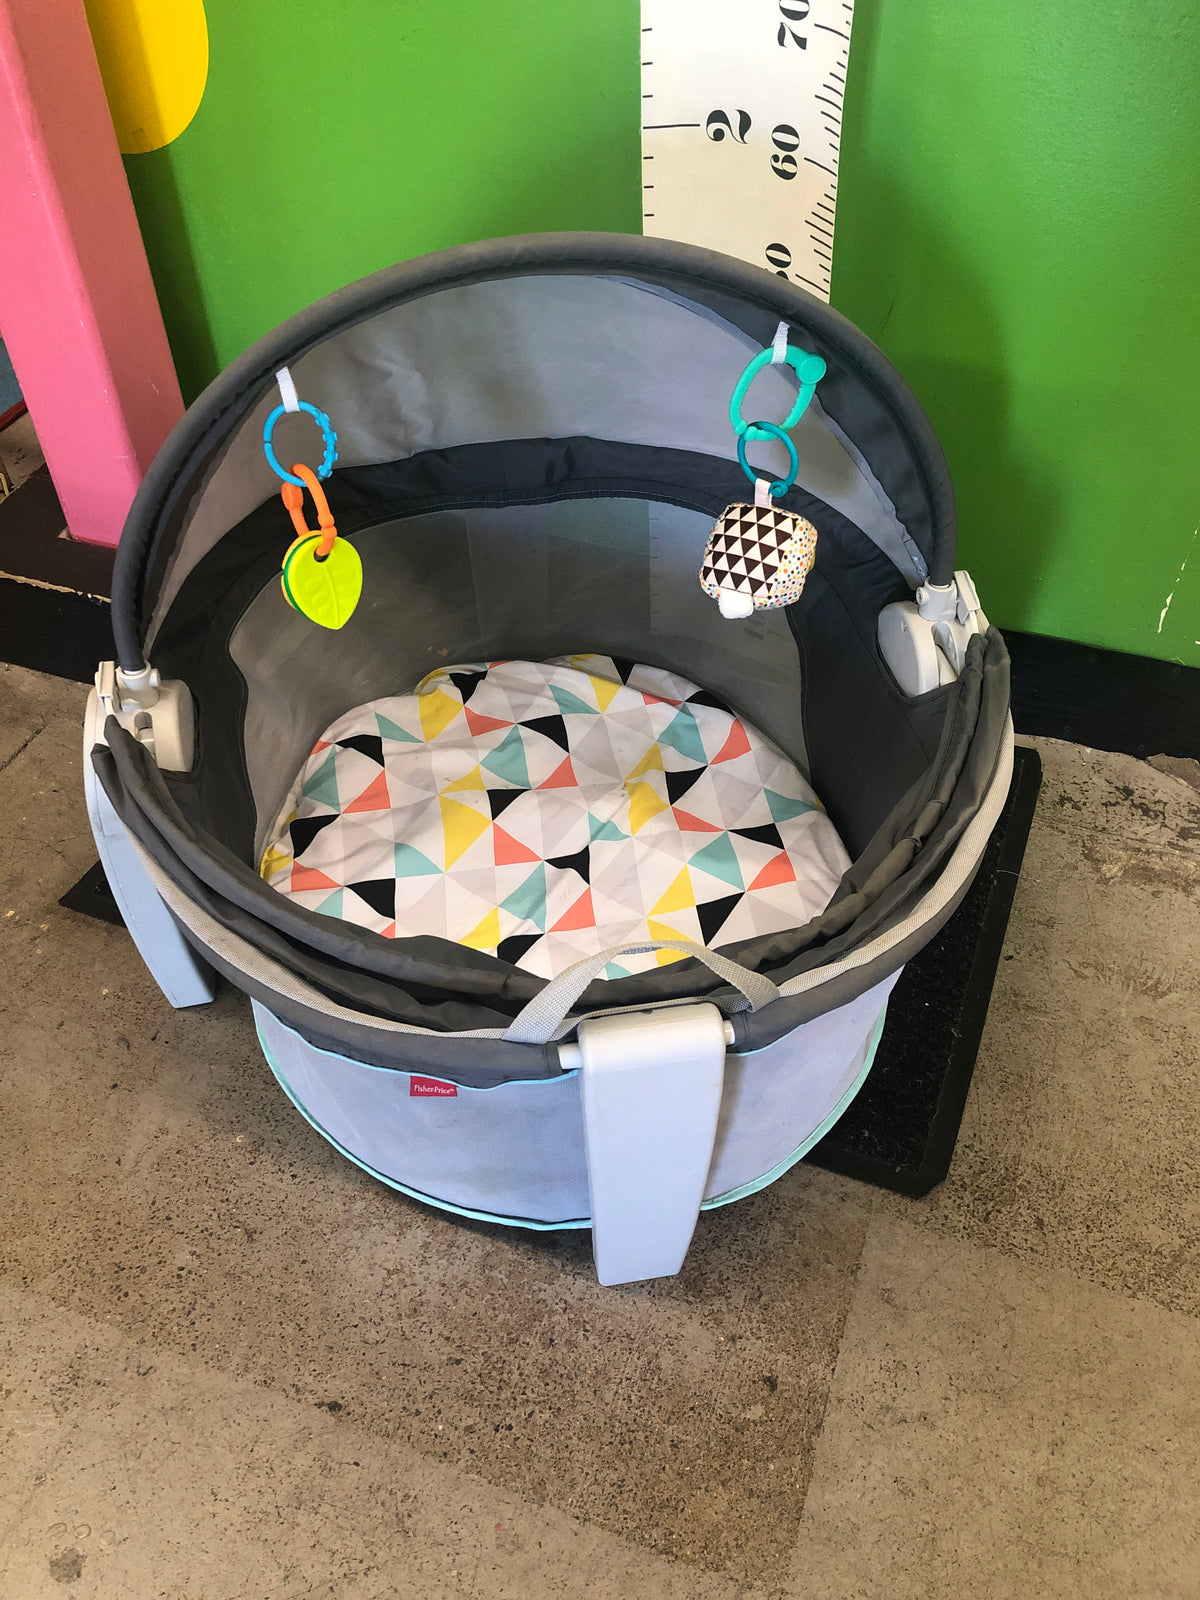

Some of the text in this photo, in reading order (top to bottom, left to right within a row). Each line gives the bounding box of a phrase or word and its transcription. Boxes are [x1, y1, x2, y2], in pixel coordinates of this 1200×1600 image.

[777, 0, 810, 50] 70
[706, 109, 752, 144] 2
[770, 124, 800, 180] 60
